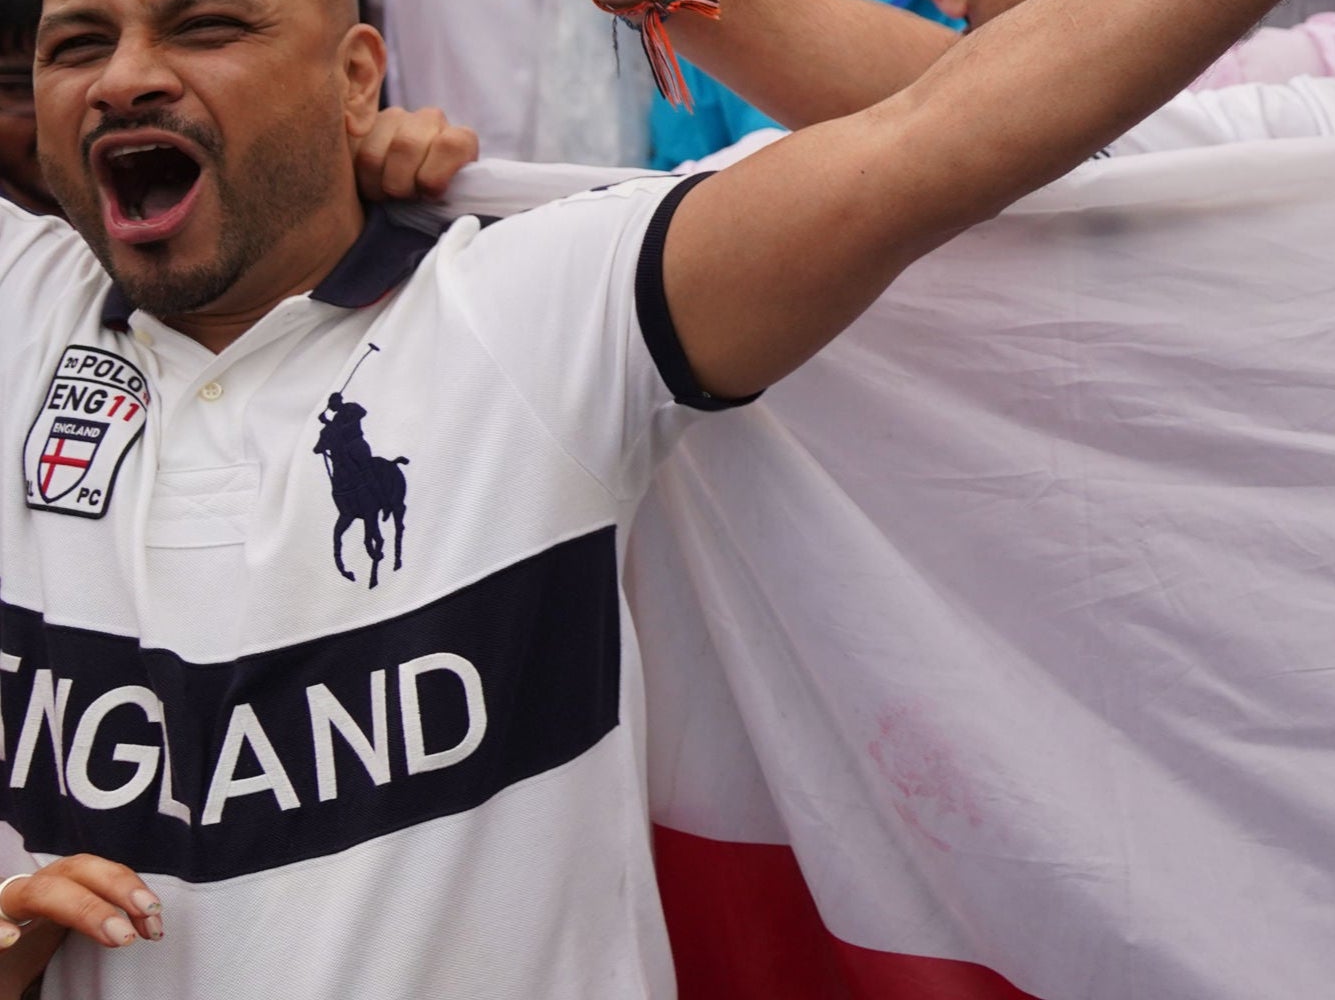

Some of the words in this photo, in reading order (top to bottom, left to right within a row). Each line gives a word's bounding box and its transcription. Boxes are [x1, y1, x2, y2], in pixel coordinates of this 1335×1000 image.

[64, 357, 79, 369] 20
[77, 355, 142, 393] POLO
[52, 423, 101, 439] ENGLAND
[76, 487, 101, 506] PC
